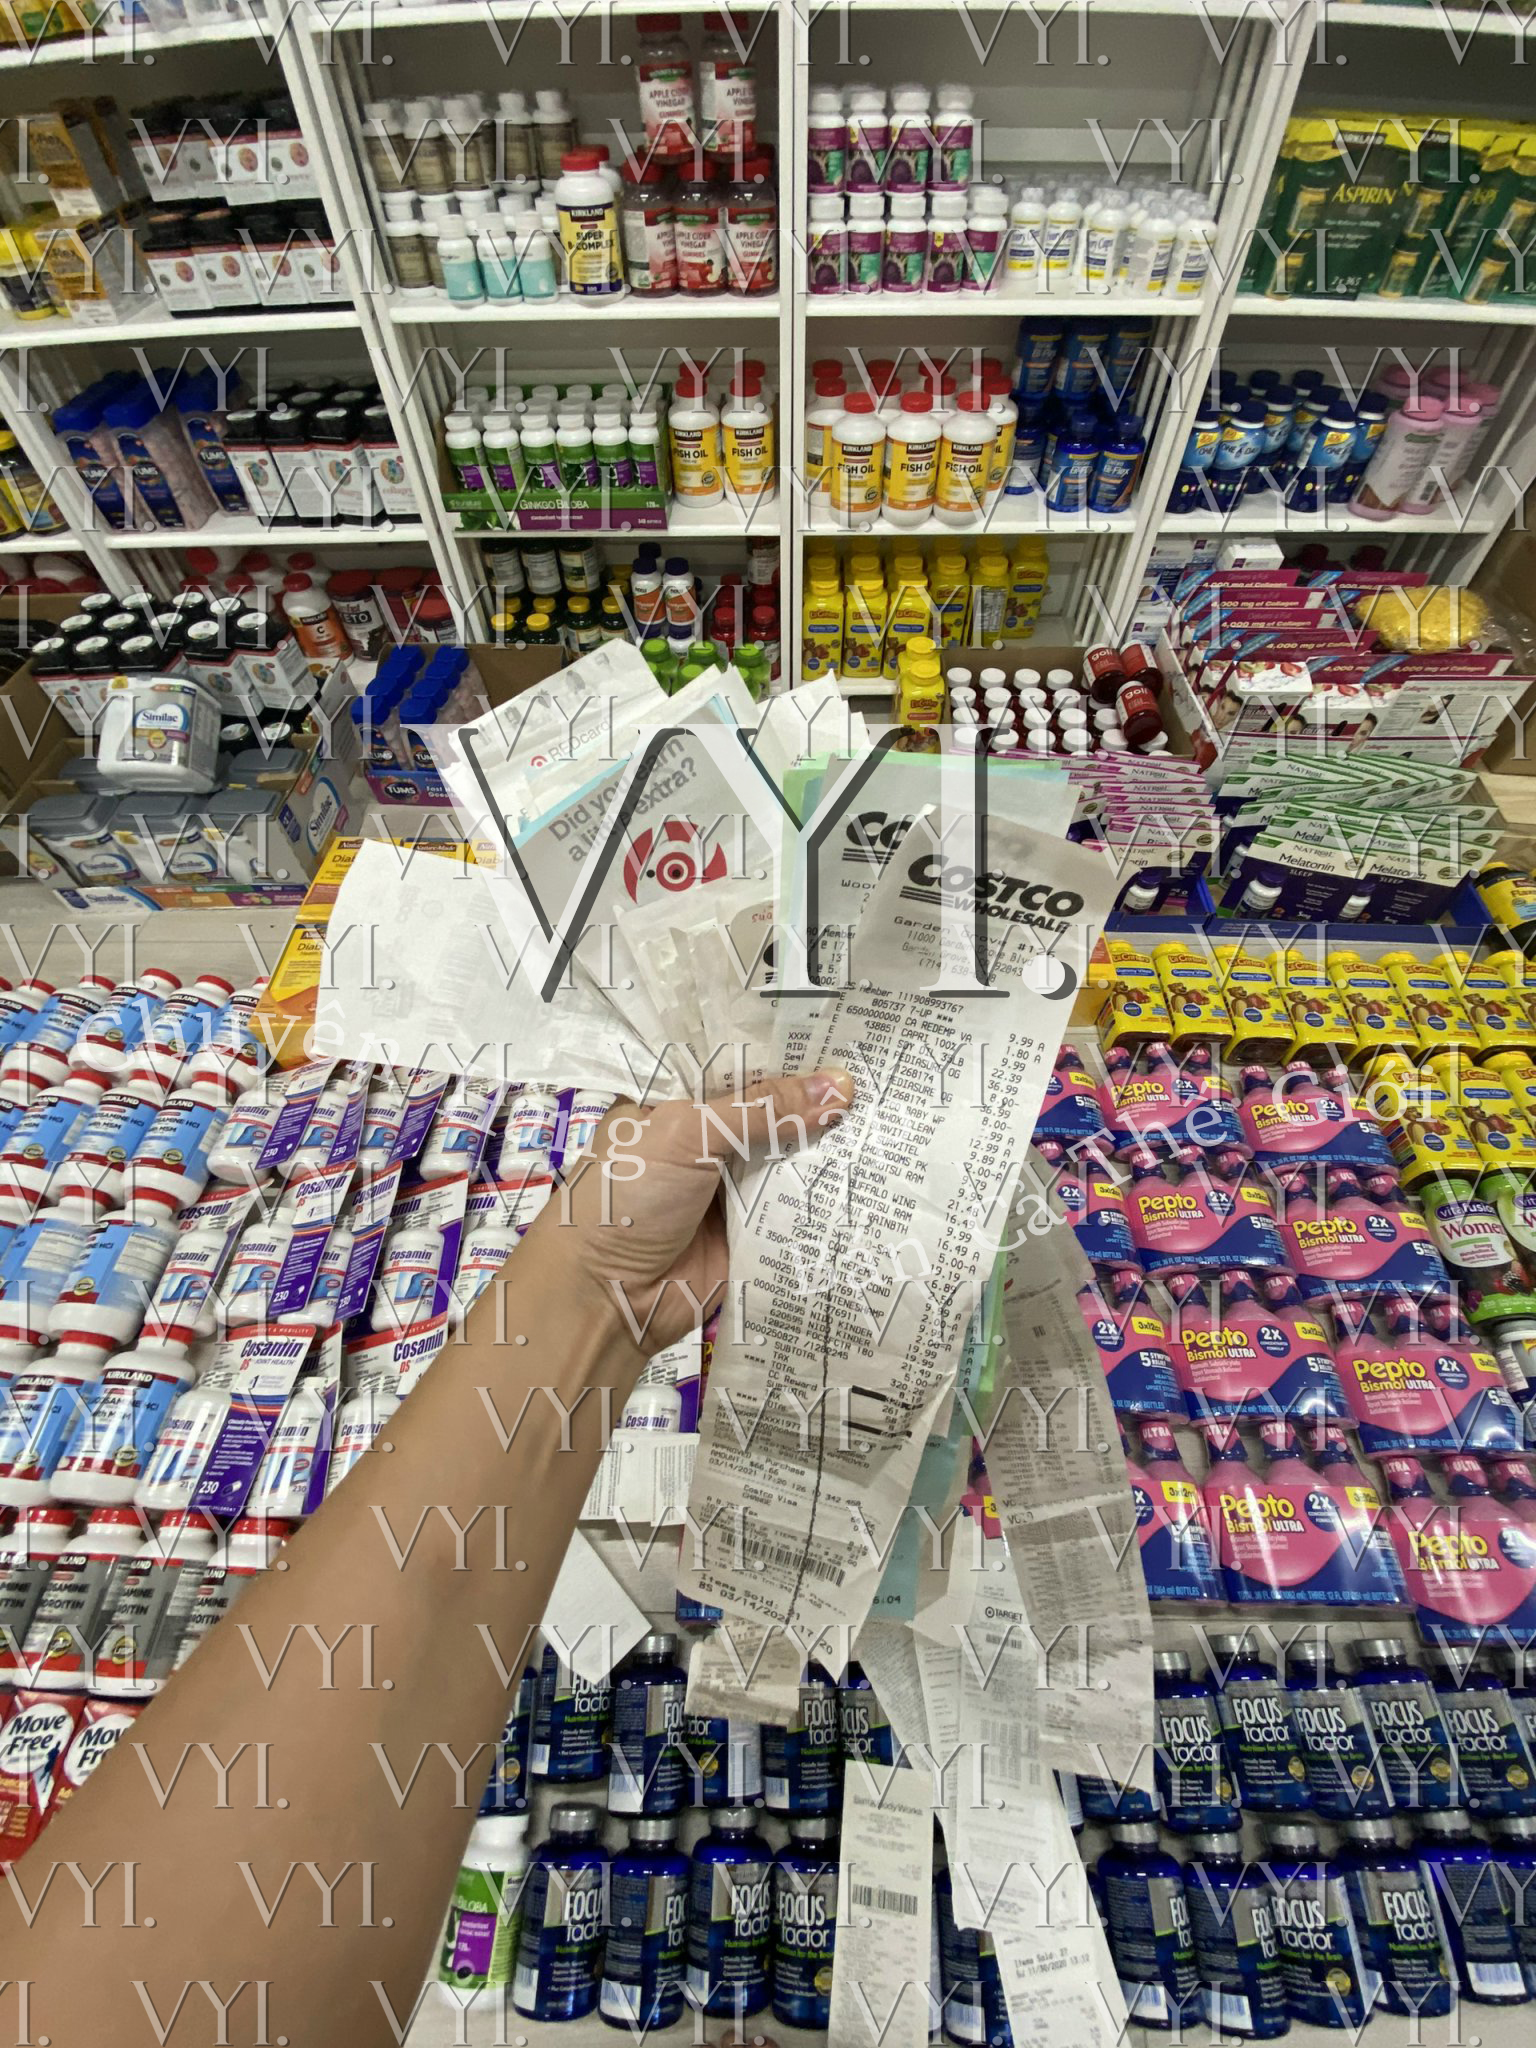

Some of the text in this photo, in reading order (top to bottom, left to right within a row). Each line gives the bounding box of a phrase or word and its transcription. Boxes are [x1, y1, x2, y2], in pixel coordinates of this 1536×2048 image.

[693, 448, 709, 458] OIL
[731, 446, 769, 458] FISH OIL
[901, 462, 922, 473] FISH
[141, 711, 180, 725] Similac
[386, 784, 417, 795] TUMS
[548, 804, 596, 842] Did
[1278, 852, 1336, 874] Melatonin
[872, 998, 933, 1018] 805737 7-UP
[864, 1020, 930, 1042] 438851 CAPRI
[866, 1031, 892, 1044] 71011
[904, 1017, 917, 1027] CA
[921, 1021, 957, 1037] REDEMP
[961, 1032, 973, 1042] VA
[1008, 1033, 1034, 1047] 9.99
[1006, 1045, 1030, 1061] 1.80
[1001, 1057, 1026, 1072] 9.99
[991, 1068, 1022, 1084] 22.39
[987, 1079, 1019, 1095] 36.99
[1110, 1081, 1165, 1104] Pepto
[1146, 1092, 1171, 1103] ULTRA
[968, 1137, 1001, 1154] 12.99
[969, 1151, 995, 1166] 9.89
[853, 1166, 886, 1185] SALMON
[906, 1171, 924, 1184] RAM
[892, 1194, 917, 1209] WING
[1137, 1192, 1198, 1214] Pepto
[893, 1208, 913, 1221] RAM
[1142, 1206, 1205, 1224] Bismol ULTRA
[947, 1227, 972, 1243] 9.99
[1292, 1216, 1357, 1239] Pepto
[937, 1238, 968, 1257] 16.49
[1298, 1232, 1366, 1249] Bismol ULTRA
[838, 1318, 873, 1338] KINDER
[393, 1328, 445, 1363] Cosamin
[836, 1331, 871, 1346] KINDER
[1181, 1327, 1249, 1350] Pepto
[240, 1337, 307, 1359] Cosamin
[773, 1352, 789, 1362] TAX
[774, 1342, 818, 1361] SUBTOTAL
[1186, 1343, 1257, 1361] Bismol ULTRA
[772, 1360, 796, 1375] TOTAL
[1352, 1358, 1427, 1380] Pepto
[105, 1370, 153, 1384] KIRKLAND
[1359, 1375, 1436, 1393] Bismol ULTRA
[198, 1480, 219, 1495] 230
[1273, 1519, 1304, 1533] ULTRA
[1233, 1696, 1283, 1725] FOCUS
[1298, 1705, 1347, 1734] FOCUS
[1371, 1700, 1424, 1728] FOCUS
[9, 1713, 67, 1734] Move
[1242, 1720, 1290, 1743] factor
[1380, 1721, 1432, 1744] factor
[7, 1733, 54, 1756] Free
[1305, 1729, 1354, 1751] factor
[779, 1892, 826, 1925] FOCUS
[781, 1923, 830, 1947] factor
